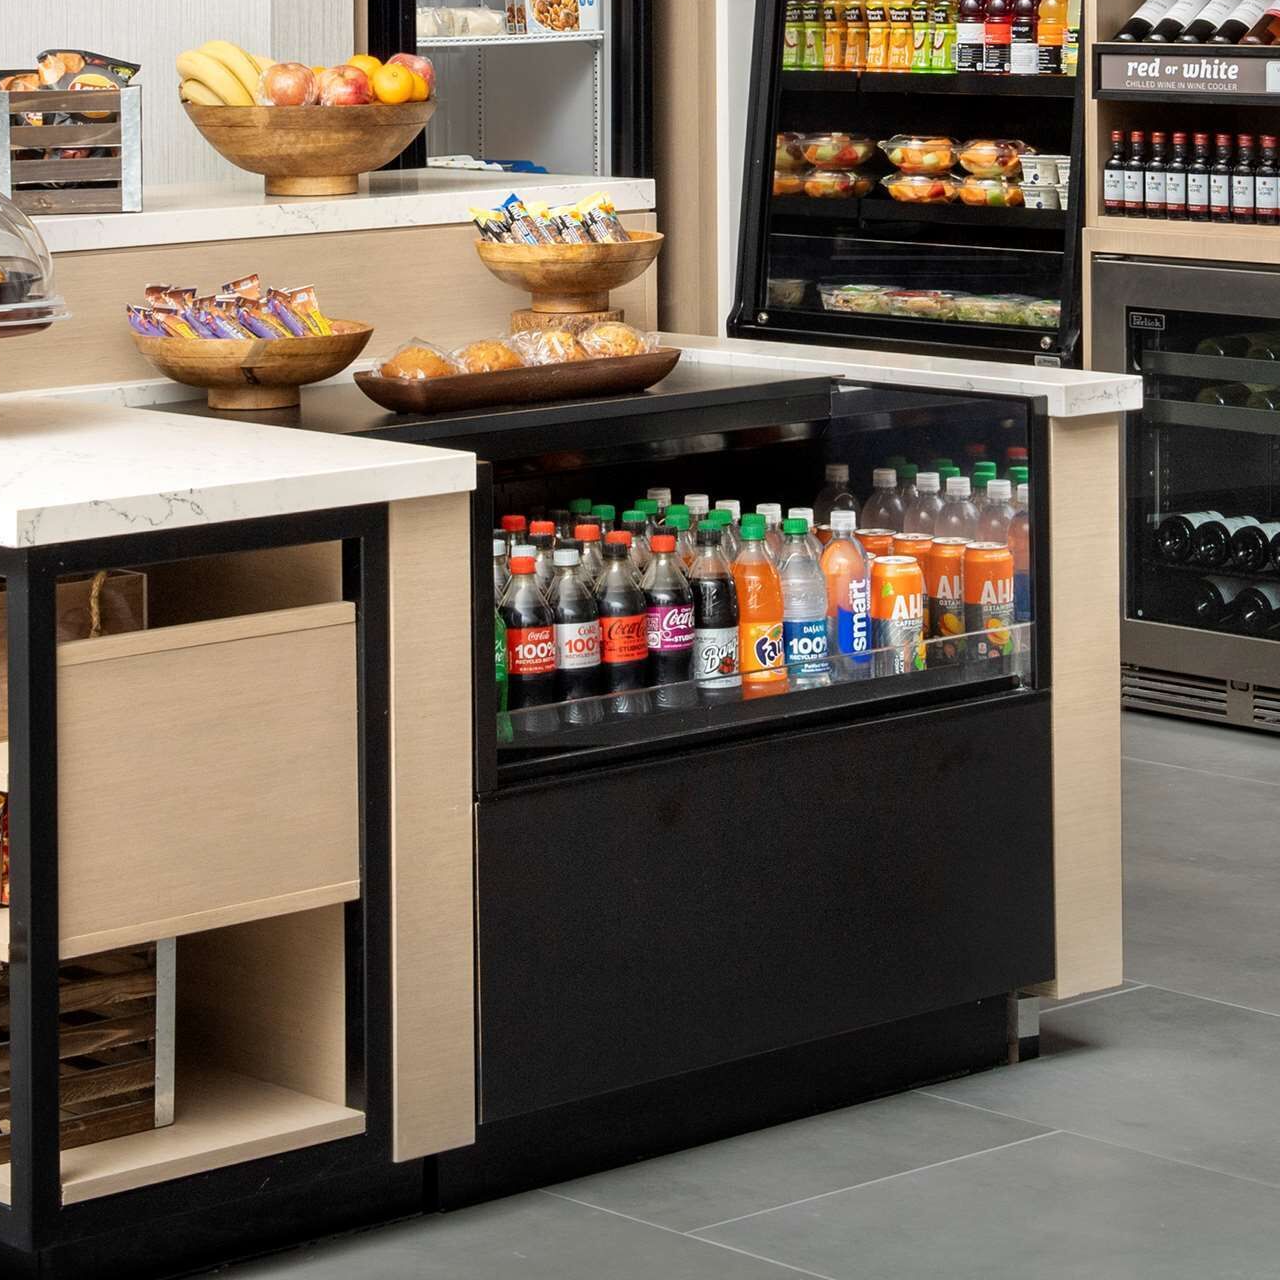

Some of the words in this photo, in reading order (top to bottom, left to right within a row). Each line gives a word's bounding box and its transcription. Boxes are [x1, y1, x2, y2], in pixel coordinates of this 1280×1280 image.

[1127, 57, 1160, 77] red
[1165, 65, 1178, 75] or
[1182, 59, 1239, 79] white
[1125, 80, 1155, 89] CHILLED
[1158, 81, 1176, 89] WINE
[1186, 82, 1206, 90] WINE
[1208, 82, 1238, 91] COOLER
[848, 579, 867, 651] smart
[515, 642, 556, 659] 100%
[565, 637, 597, 654] 100
